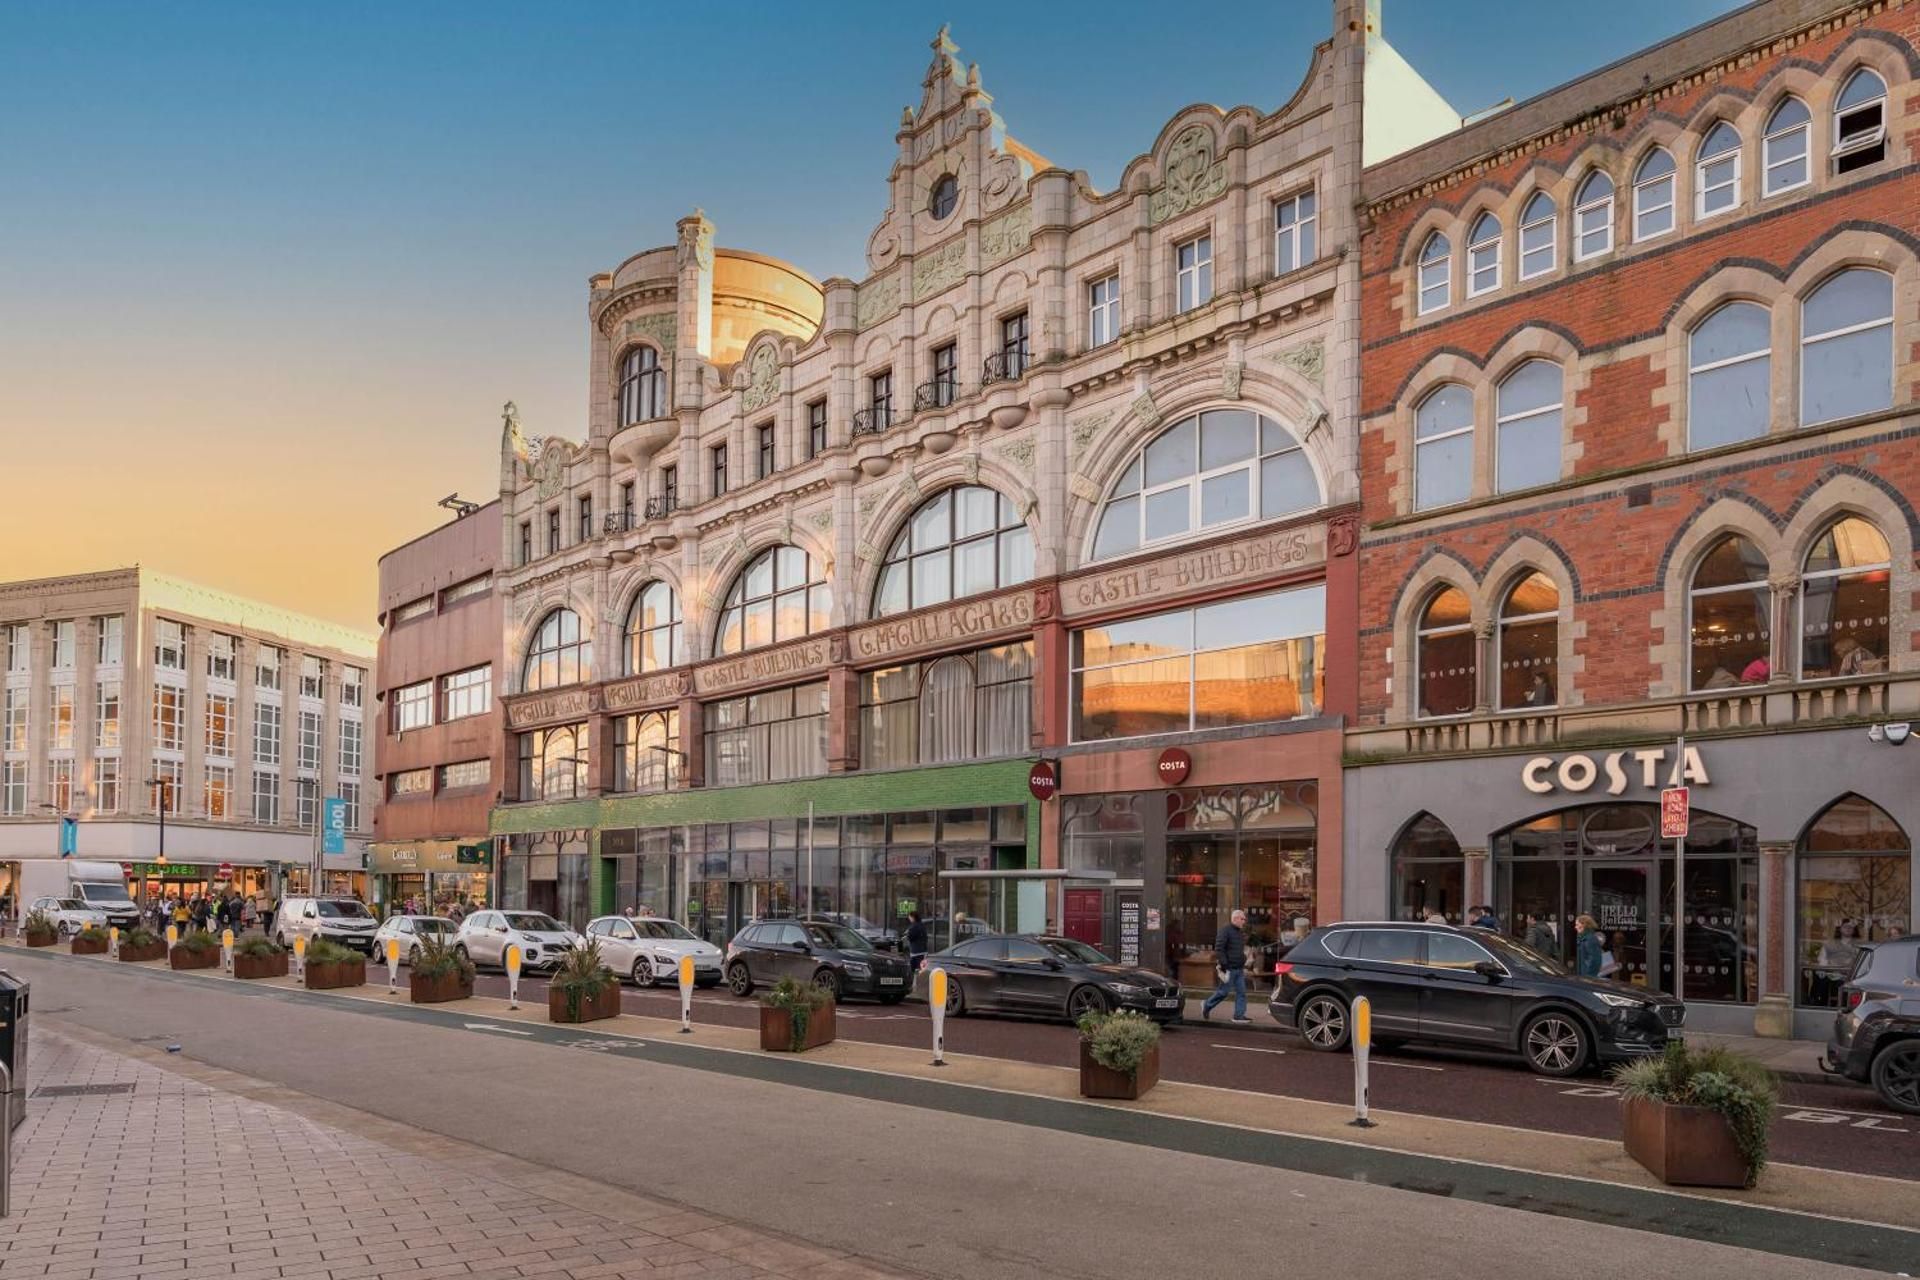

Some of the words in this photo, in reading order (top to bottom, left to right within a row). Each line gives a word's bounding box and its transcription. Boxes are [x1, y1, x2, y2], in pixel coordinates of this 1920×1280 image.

[1078, 567, 1161, 606] CASTLE
[1176, 533, 1310, 588] BUILDINGS
[1000, 604, 1012, 625] &
[703, 662, 749, 689] CASTLE
[752, 644, 824, 678] BUILDINGS
[1160, 761, 1185, 770] COSTA
[1521, 746, 1710, 796] COSTA
[1031, 775, 1054, 786] COSTA
[1600, 904, 1638, 917] HELLO
